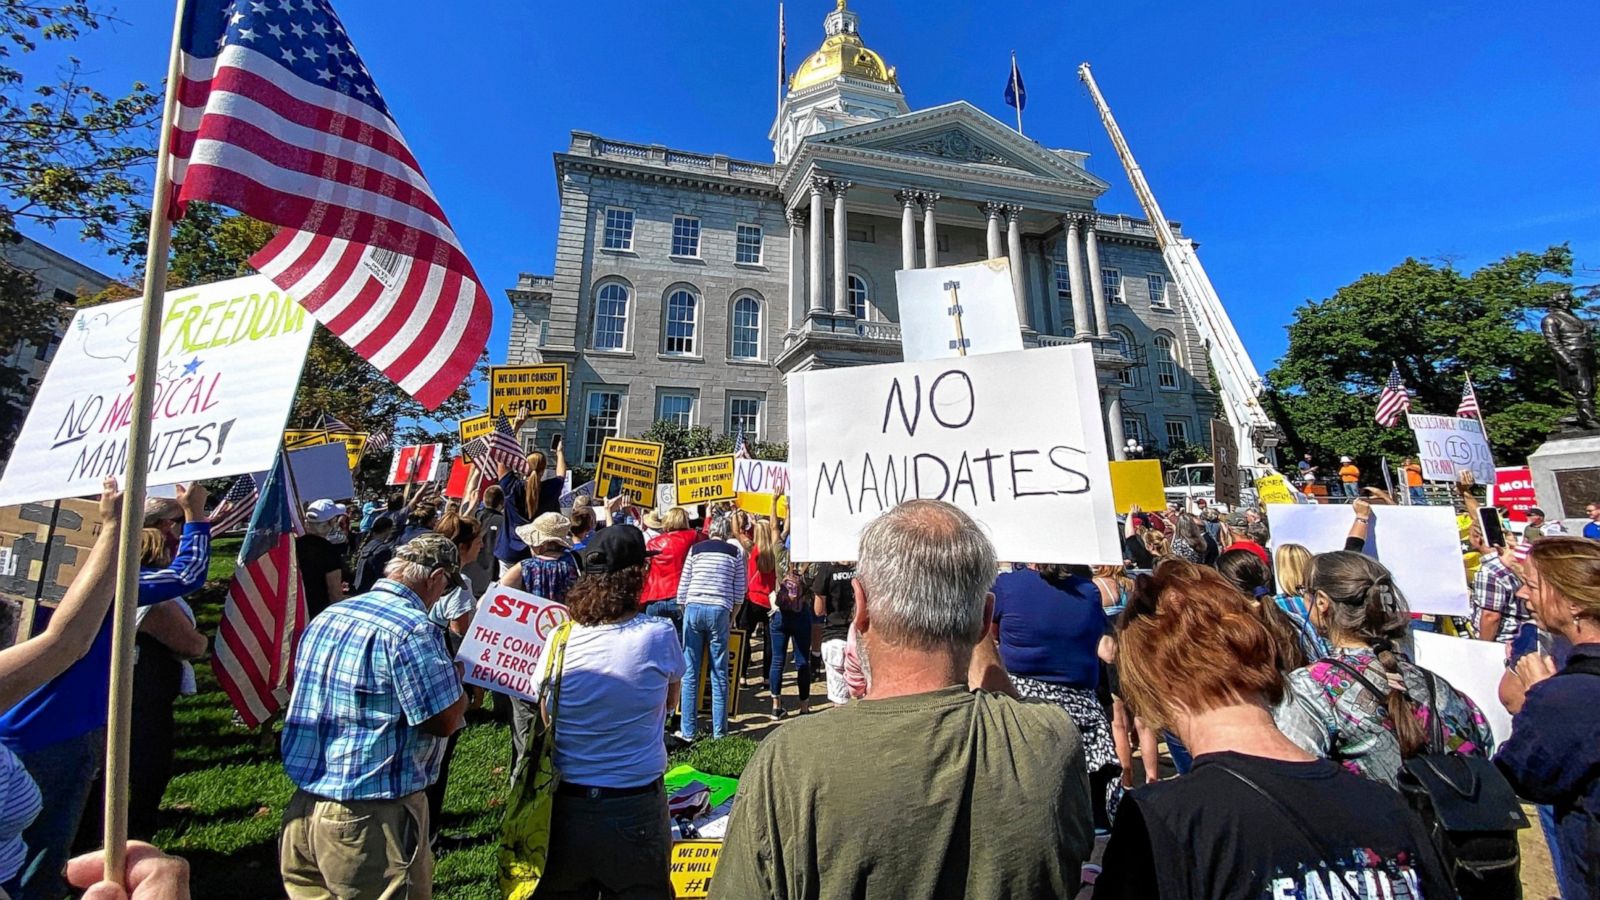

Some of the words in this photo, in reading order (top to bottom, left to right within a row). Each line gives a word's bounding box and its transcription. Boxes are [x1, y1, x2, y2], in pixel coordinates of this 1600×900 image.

[160, 291, 305, 357] FREEDOM
[498, 374, 508, 383] WE
[509, 374, 517, 383] DO
[519, 373, 530, 382] NOT
[531, 372, 558, 382] CONSENT
[495, 387, 504, 396] WE
[506, 387, 520, 396] WILL
[523, 386, 534, 395] NOT
[535, 385, 560, 395] COMPLY
[508, 398, 547, 413] #FAFO
[882, 369, 975, 437] NO
[54, 395, 104, 440] NO
[1411, 416, 1456, 431] RESISTANCE
[67, 418, 237, 482] MANATES!
[634, 447, 656, 457] CONSENT
[1424, 440, 1442, 457] TO
[1447, 441, 1469, 460] IS
[1472, 443, 1489, 461] TO
[681, 467, 689, 475] WE
[697, 464, 707, 473] NOT
[708, 461, 729, 471] CONSENT
[679, 478, 687, 486] WE
[688, 477, 700, 485] WILL
[702, 475, 711, 484] NOT
[712, 472, 732, 482] COMPLY
[736, 461, 763, 492] NO
[812, 445, 1091, 518] MANDATES
[691, 484, 723, 499] #FAFO
[1499, 480, 1534, 493] MOL
[474, 626, 502, 646] THE
[480, 648, 491, 663] &
[678, 848, 693, 858] WE
[695, 848, 709, 858] DO
[670, 862, 684, 872] WE
[687, 862, 712, 872] WILL
